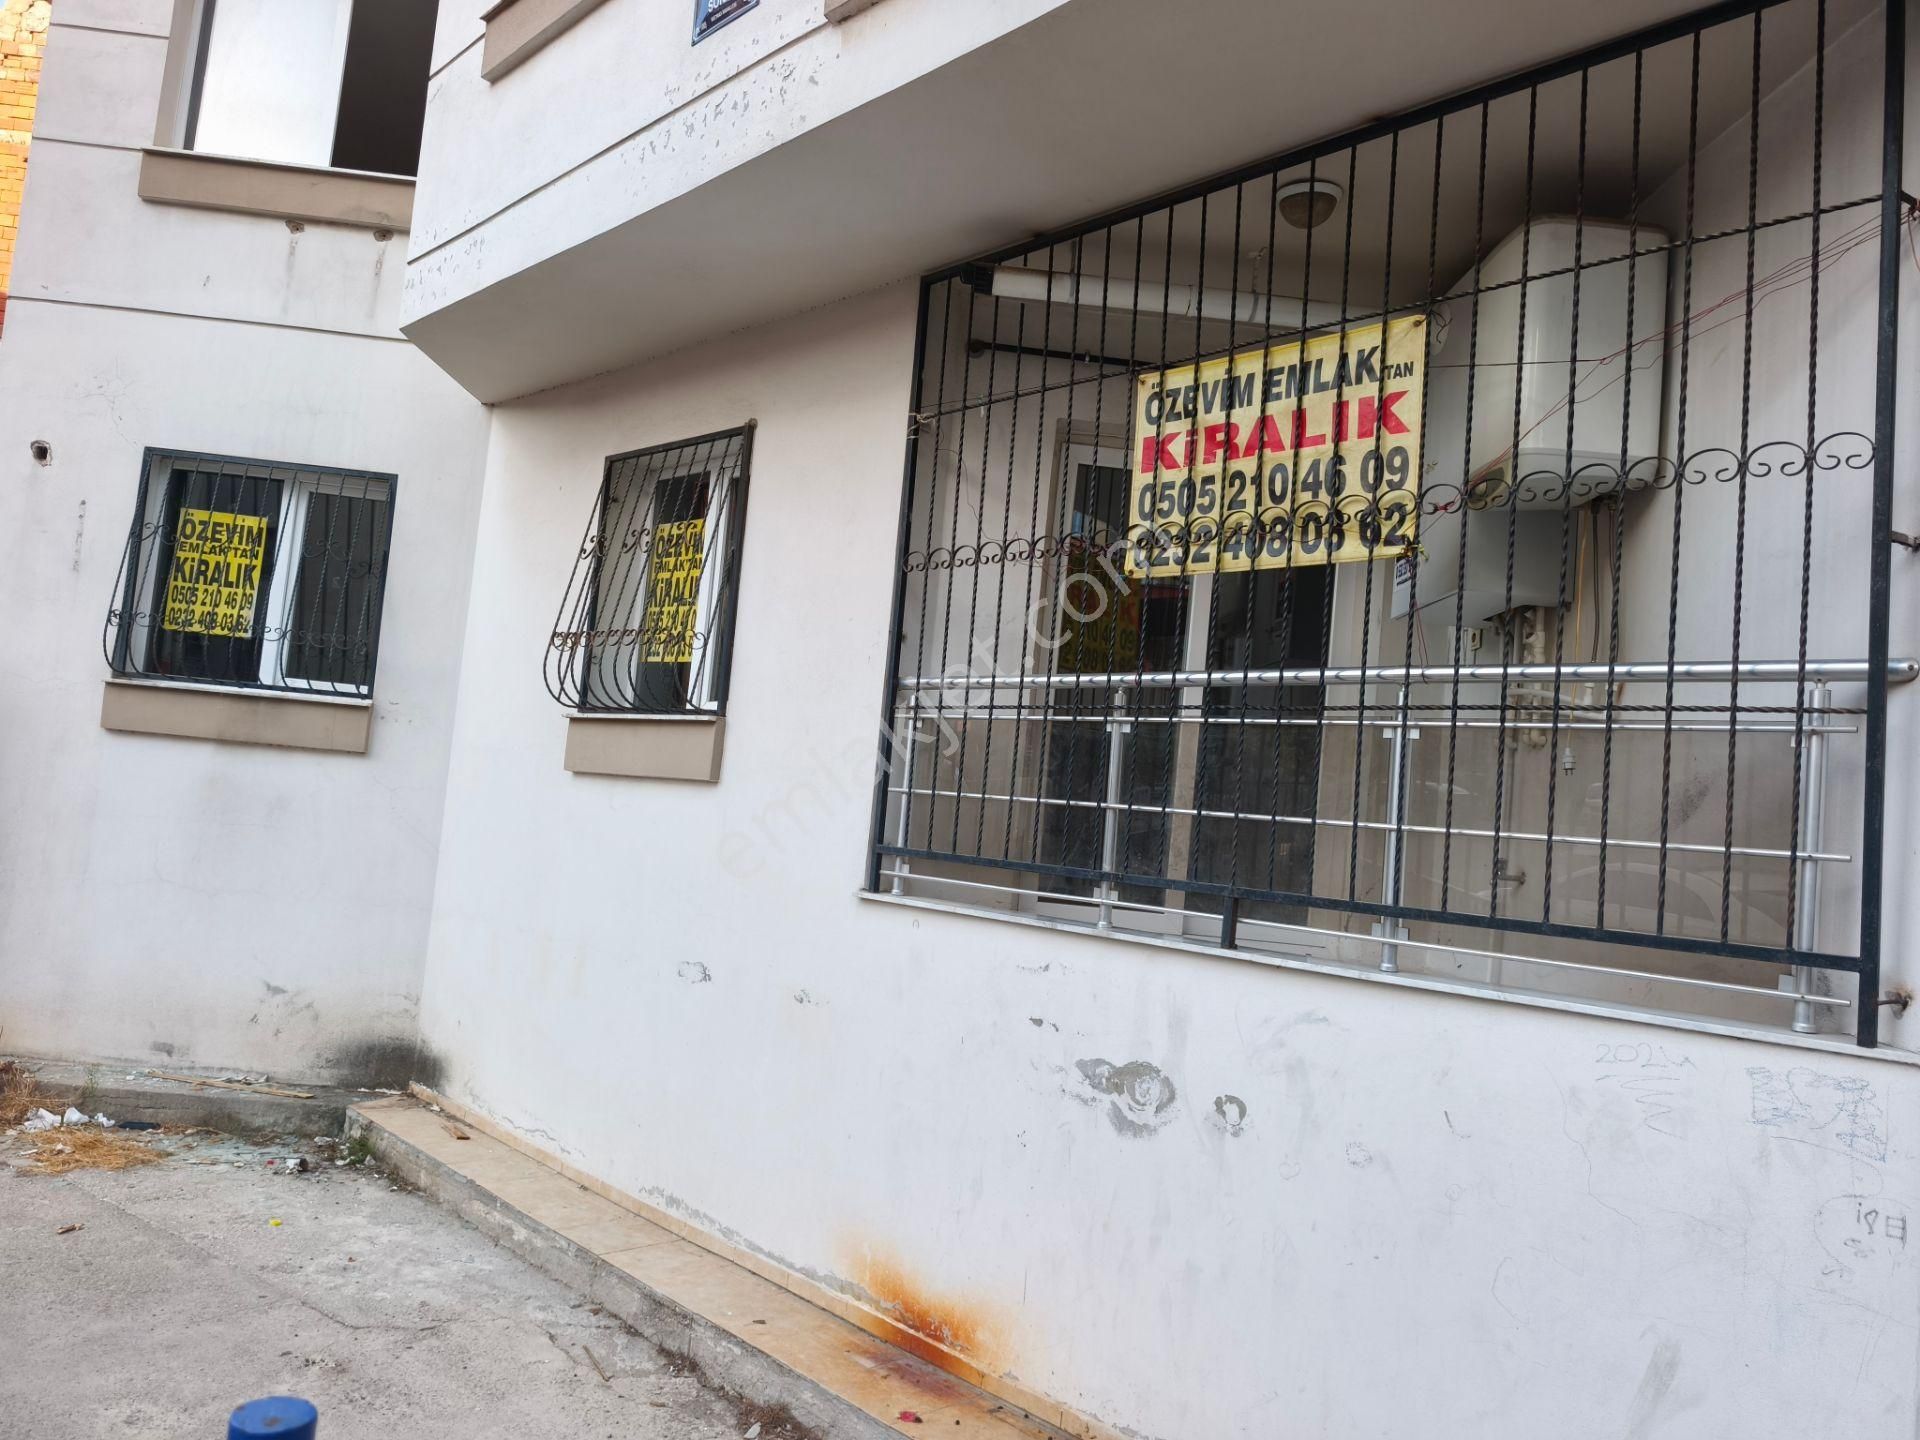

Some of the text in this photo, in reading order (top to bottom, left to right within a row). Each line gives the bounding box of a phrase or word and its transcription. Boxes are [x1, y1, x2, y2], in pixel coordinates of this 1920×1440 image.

[1145, 368, 1256, 425] ÖZEVİM
[1264, 345, 1380, 404] EMLAK
[1138, 446, 1409, 521] 0505 210 46 09
[181, 512, 264, 548] ÖZEVİM
[1222, 516, 1288, 560] 408
[172, 585, 253, 611] 0505 210 46 09
